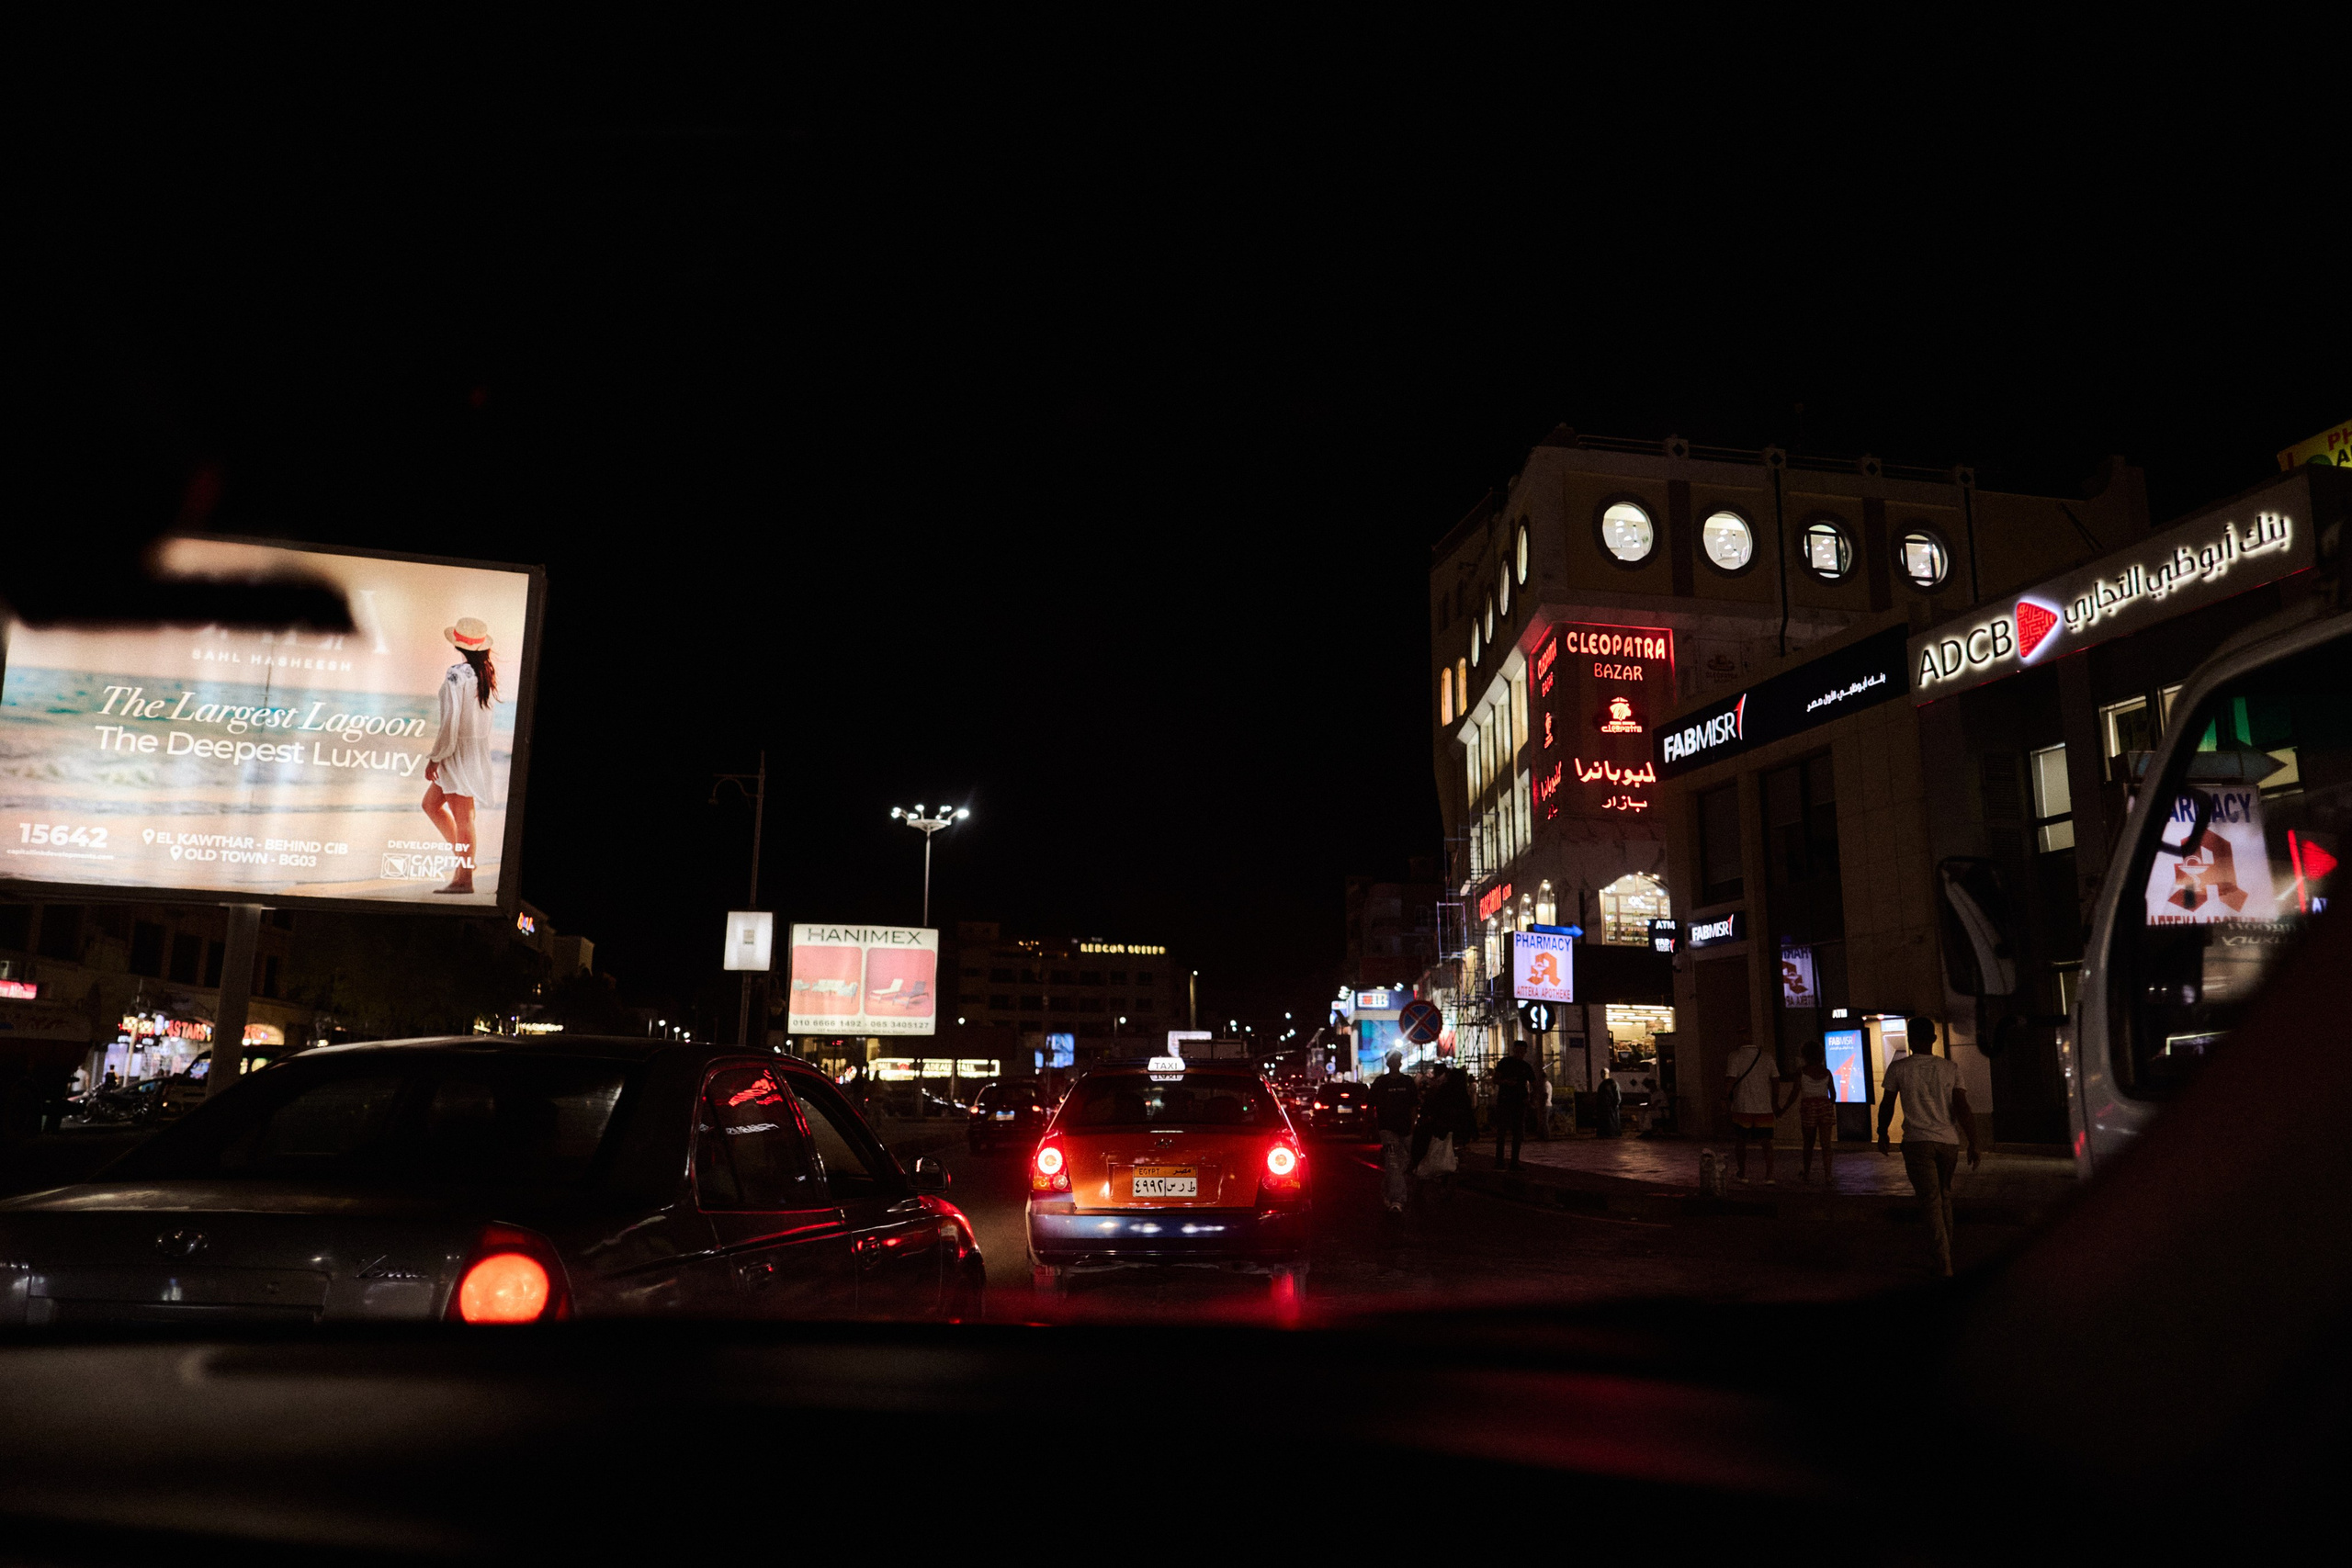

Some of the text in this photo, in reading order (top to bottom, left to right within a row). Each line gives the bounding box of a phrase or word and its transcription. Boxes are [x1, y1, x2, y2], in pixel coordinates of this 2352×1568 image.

[2238, 514, 2290, 553] بنك
[2064, 565, 2142, 630] التجاري
[1566, 631, 1666, 660] CLEOPATRA
[1917, 619, 2013, 686] ADCB
[191, 648, 352, 672] SAHL HASHEESH
[1594, 662, 1644, 682] BAZAR
[96, 684, 426, 743] The Largest Lagoon
[1663, 711, 1736, 764] FABMISR
[95, 725, 424, 777] The Deepest Luxury
[1574, 757, 1657, 789] ليوباترا
[1600, 795, 1648, 813] بازار
[18, 822, 108, 849] 15642
[156, 831, 175, 845] EL
[176, 833, 254, 850] KAWTHAR
[265, 839, 322, 854] BEHIND
[323, 840, 349, 855] CIB
[388, 840, 470, 852] DEVELOPED BY
[184, 847, 218, 863] OLD
[220, 849, 268, 865] TOWN
[278, 853, 317, 868] BG03
[411, 854, 476, 870] CAPITAL
[410, 864, 446, 879] LINK
[1655, 919, 1676, 931] ATM
[1691, 920, 1730, 942] FABMISR
[807, 927, 923, 946] HANIMEX
[1515, 933, 1571, 952] PHARMACY
[1831, 1008, 1849, 1019] ATM
[840, 1020, 862, 1028] 1492
[1154, 1062, 1178, 1070] TAXI
[1138, 1168, 1160, 1176] EGYPT
[1172, 1168, 1192, 1176] مصر
